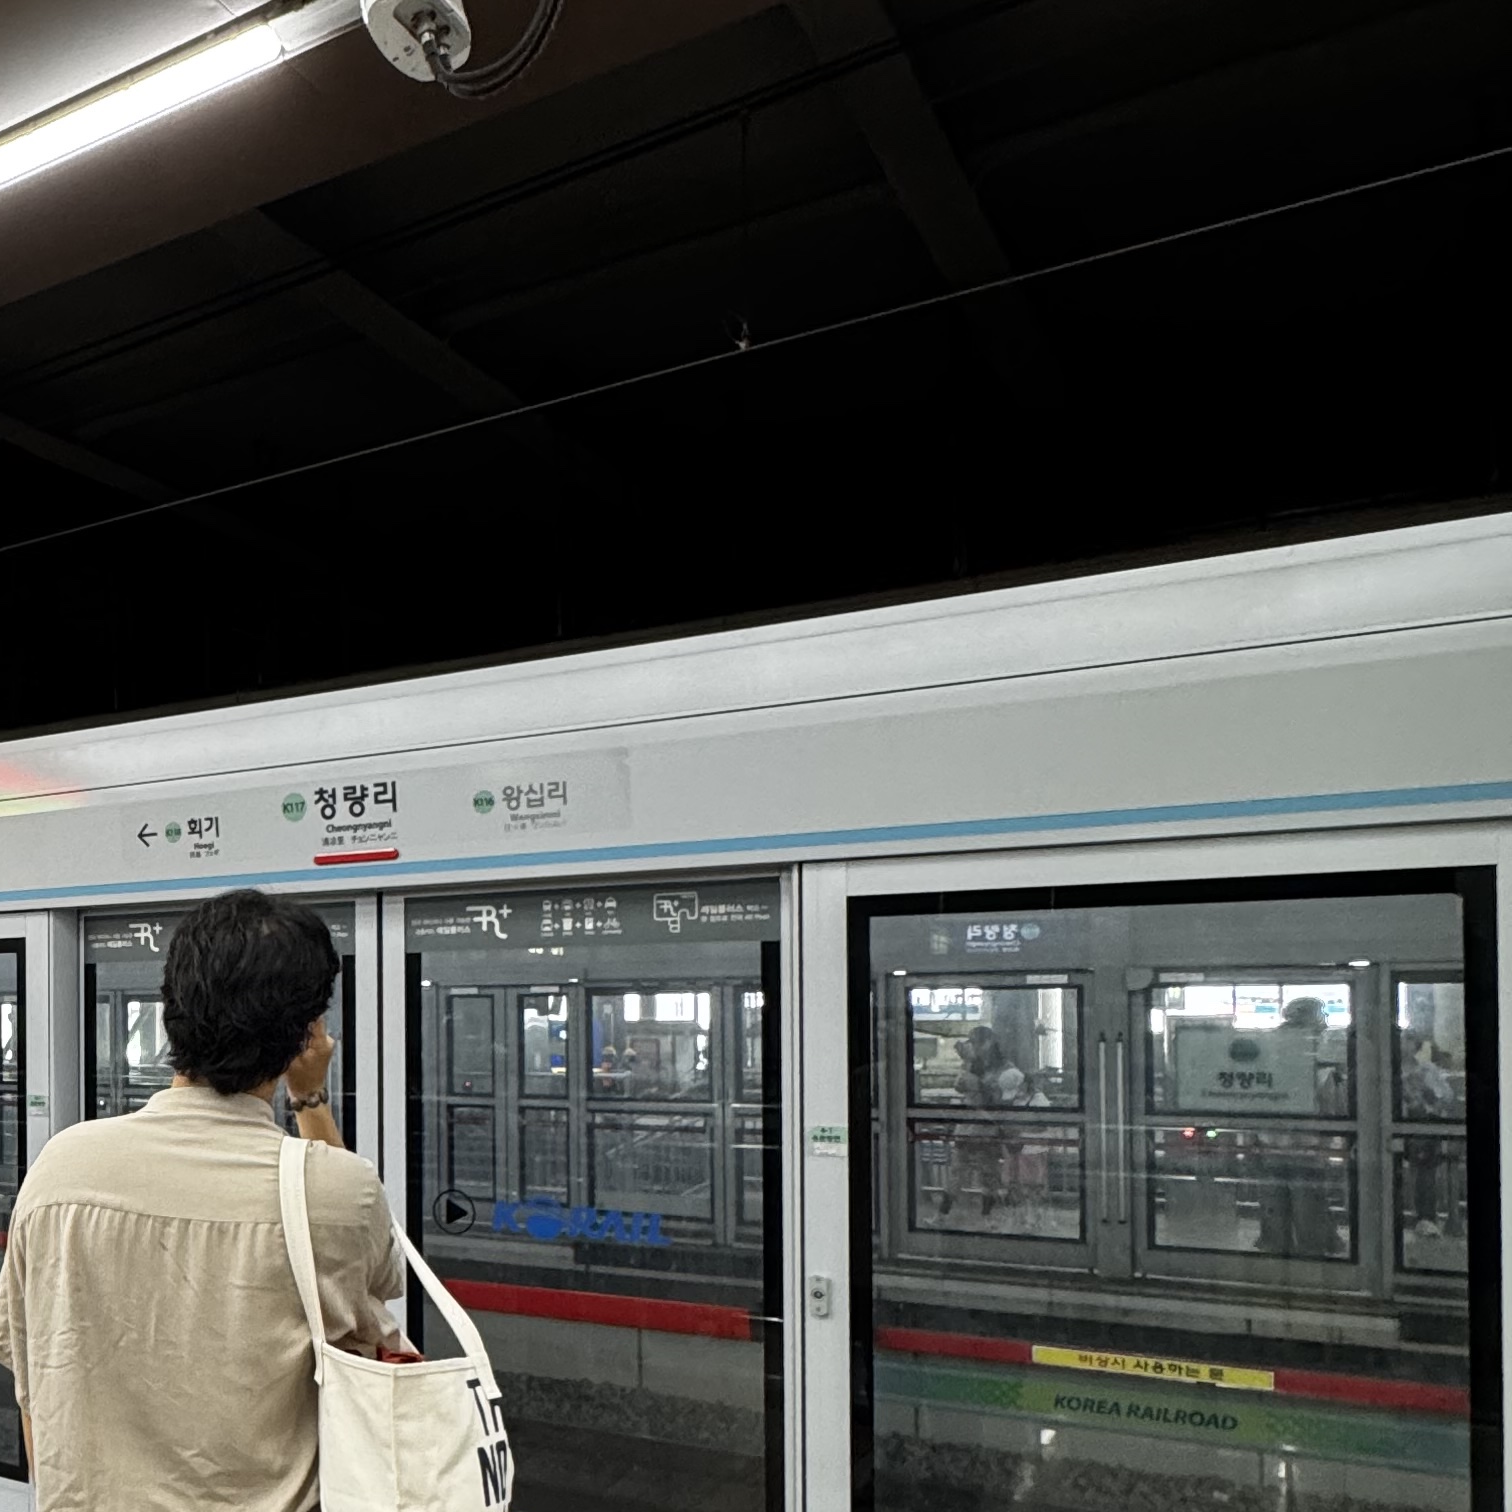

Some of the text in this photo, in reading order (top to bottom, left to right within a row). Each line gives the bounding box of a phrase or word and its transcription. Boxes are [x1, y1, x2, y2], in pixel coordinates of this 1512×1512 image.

[282, 800, 306, 815] K117
[314, 781, 397, 820] 청량리
[502, 781, 568, 811] 왕십리
[187, 816, 220, 839] 회기
[326, 818, 393, 834] Cheongnyangni
[1078, 1353, 1126, 1371] 비상시
[1133, 1360, 1201, 1379] 사용하는
[1053, 1393, 1239, 1431] KOREA RAILROAD
